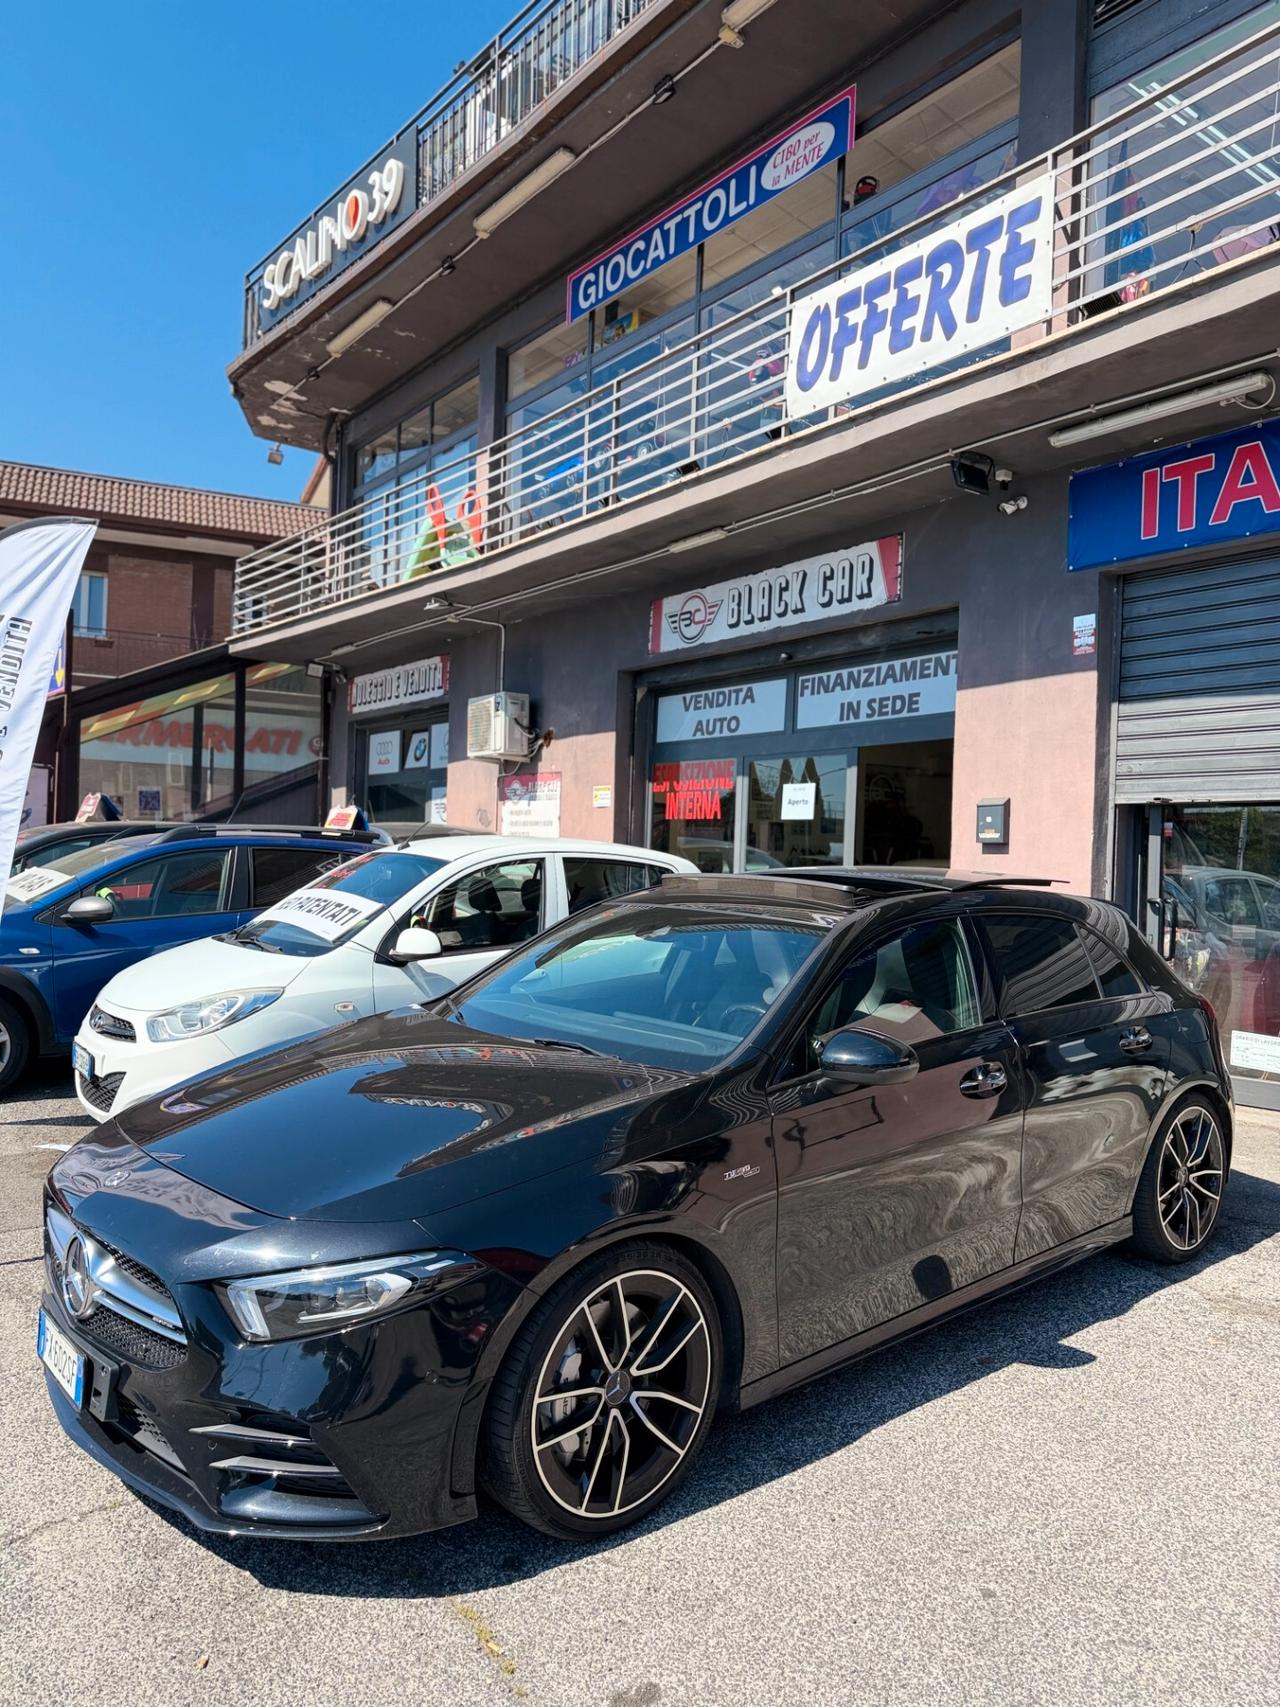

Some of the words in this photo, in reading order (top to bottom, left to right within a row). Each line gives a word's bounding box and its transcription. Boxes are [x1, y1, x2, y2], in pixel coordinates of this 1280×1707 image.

[771, 175, 781, 188] la
[784, 141, 825, 179] MENTE
[772, 138, 801, 169] CIBO
[803, 131, 821, 151] per
[578, 164, 757, 310] GIOCATTOLI
[796, 195, 1043, 393] OFFERTE
[1140, 441, 1280, 540] ITA
[726, 569, 808, 629] BLACK
[816, 552, 875, 608] CAR
[682, 686, 756, 712] VENDITA
[839, 700, 862, 722] IN
[865, 692, 921, 719] SEDE
[692, 715, 741, 737] AUTO
[665, 790, 721, 820] INTERNA
